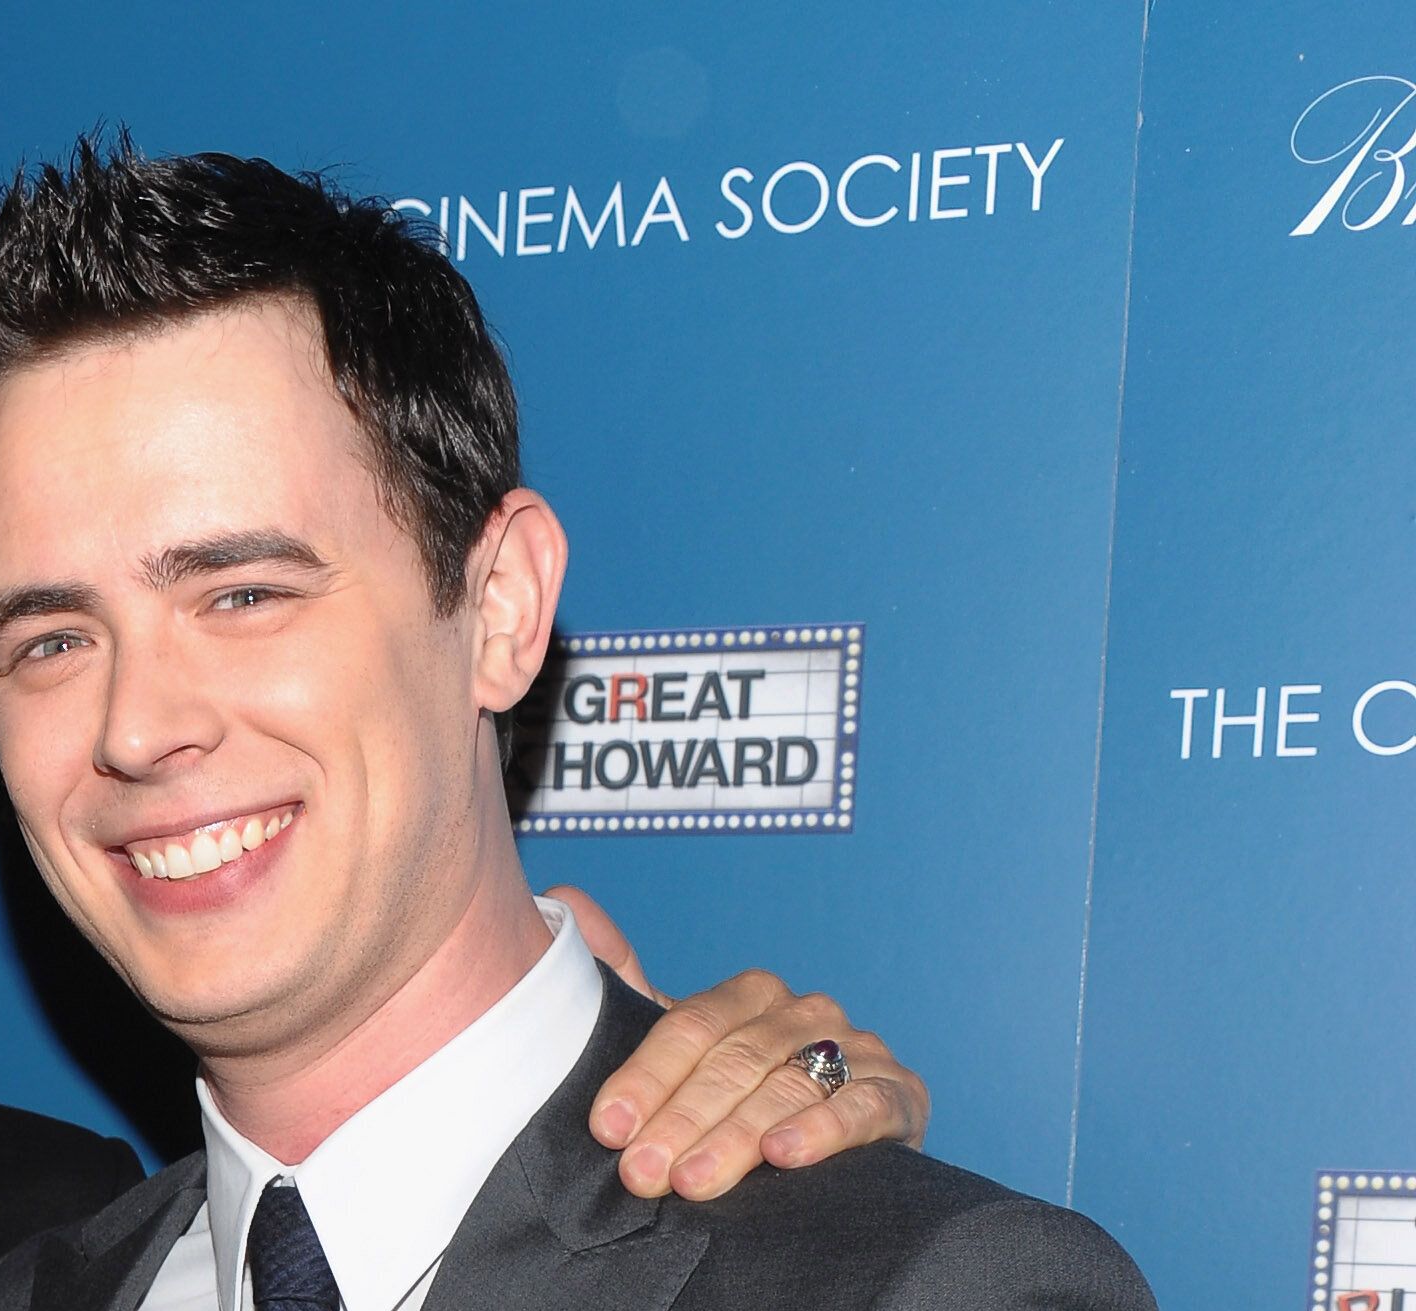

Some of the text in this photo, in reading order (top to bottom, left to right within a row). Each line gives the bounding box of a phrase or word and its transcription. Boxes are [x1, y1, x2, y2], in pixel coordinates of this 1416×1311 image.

[715, 138, 1064, 239] SOCIETY
[564, 669, 766, 725] GREAT
[1170, 684, 1322, 760] THE
[552, 736, 819, 791] HOWARD
